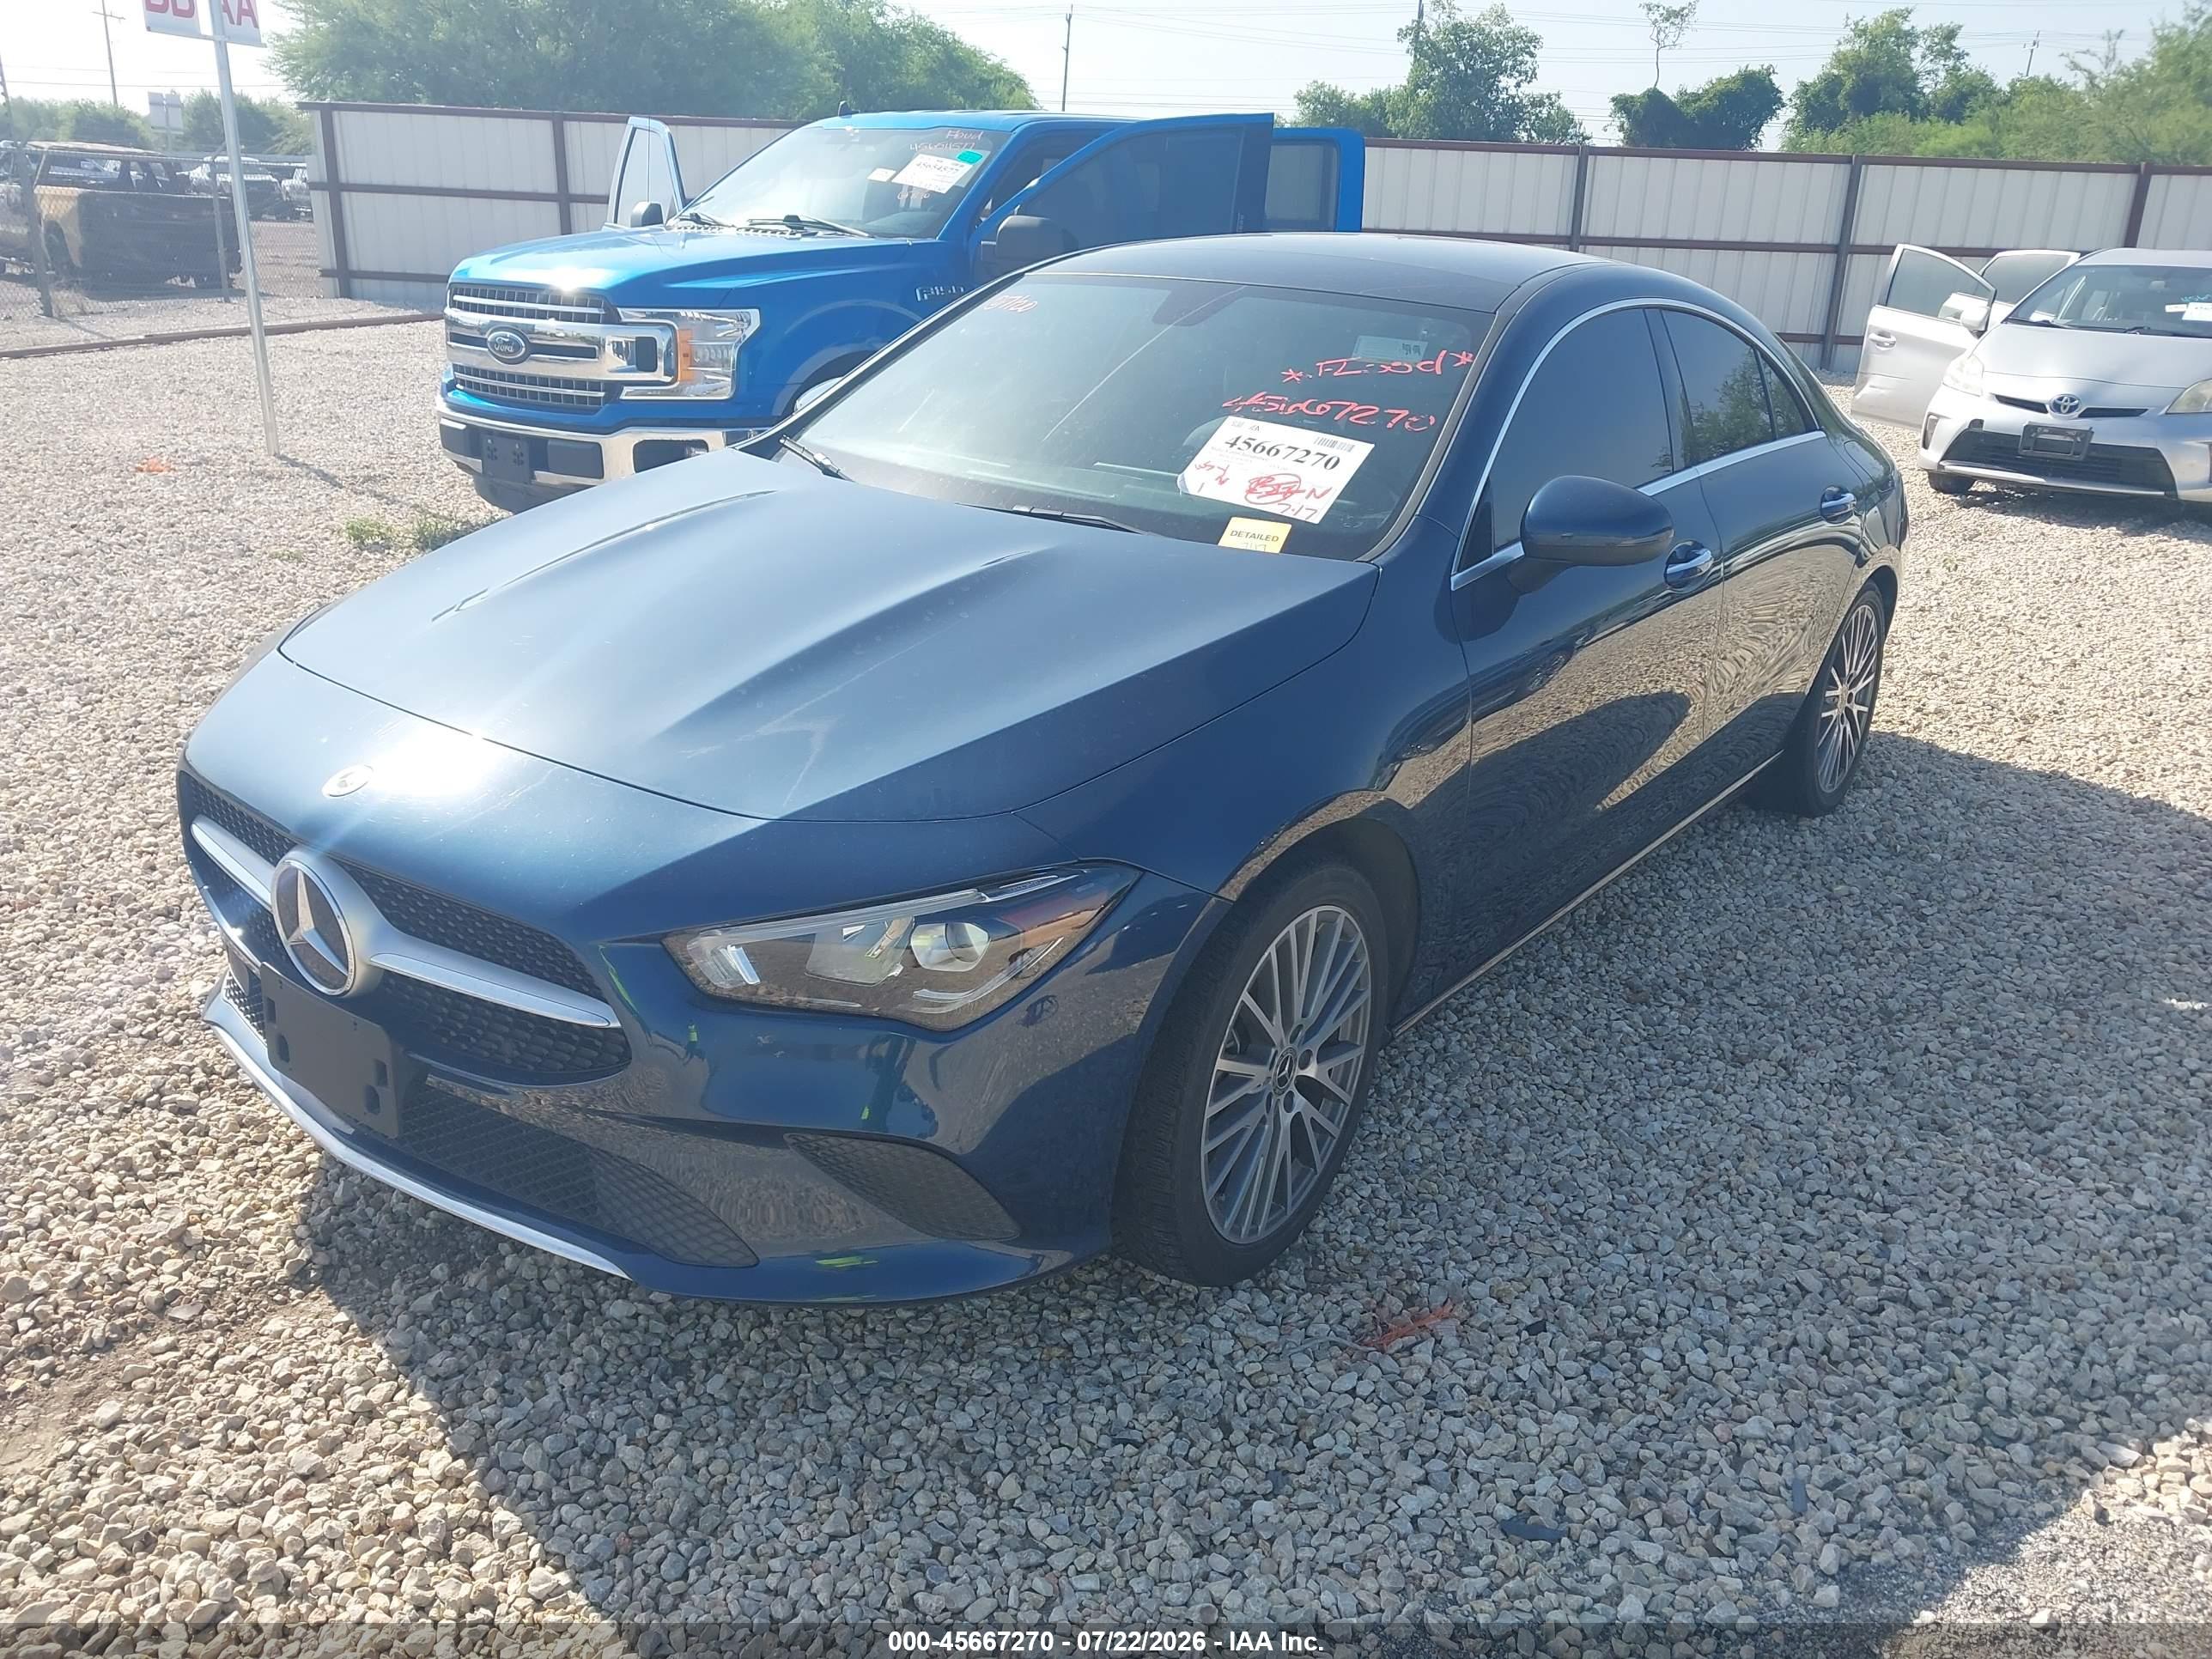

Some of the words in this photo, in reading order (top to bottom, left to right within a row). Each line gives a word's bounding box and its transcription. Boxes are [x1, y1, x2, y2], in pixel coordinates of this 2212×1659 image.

[494, 336, 514, 352] Ford
[1224, 434, 1341, 471] 45667270
[1230, 529, 1280, 543] DETAILED
